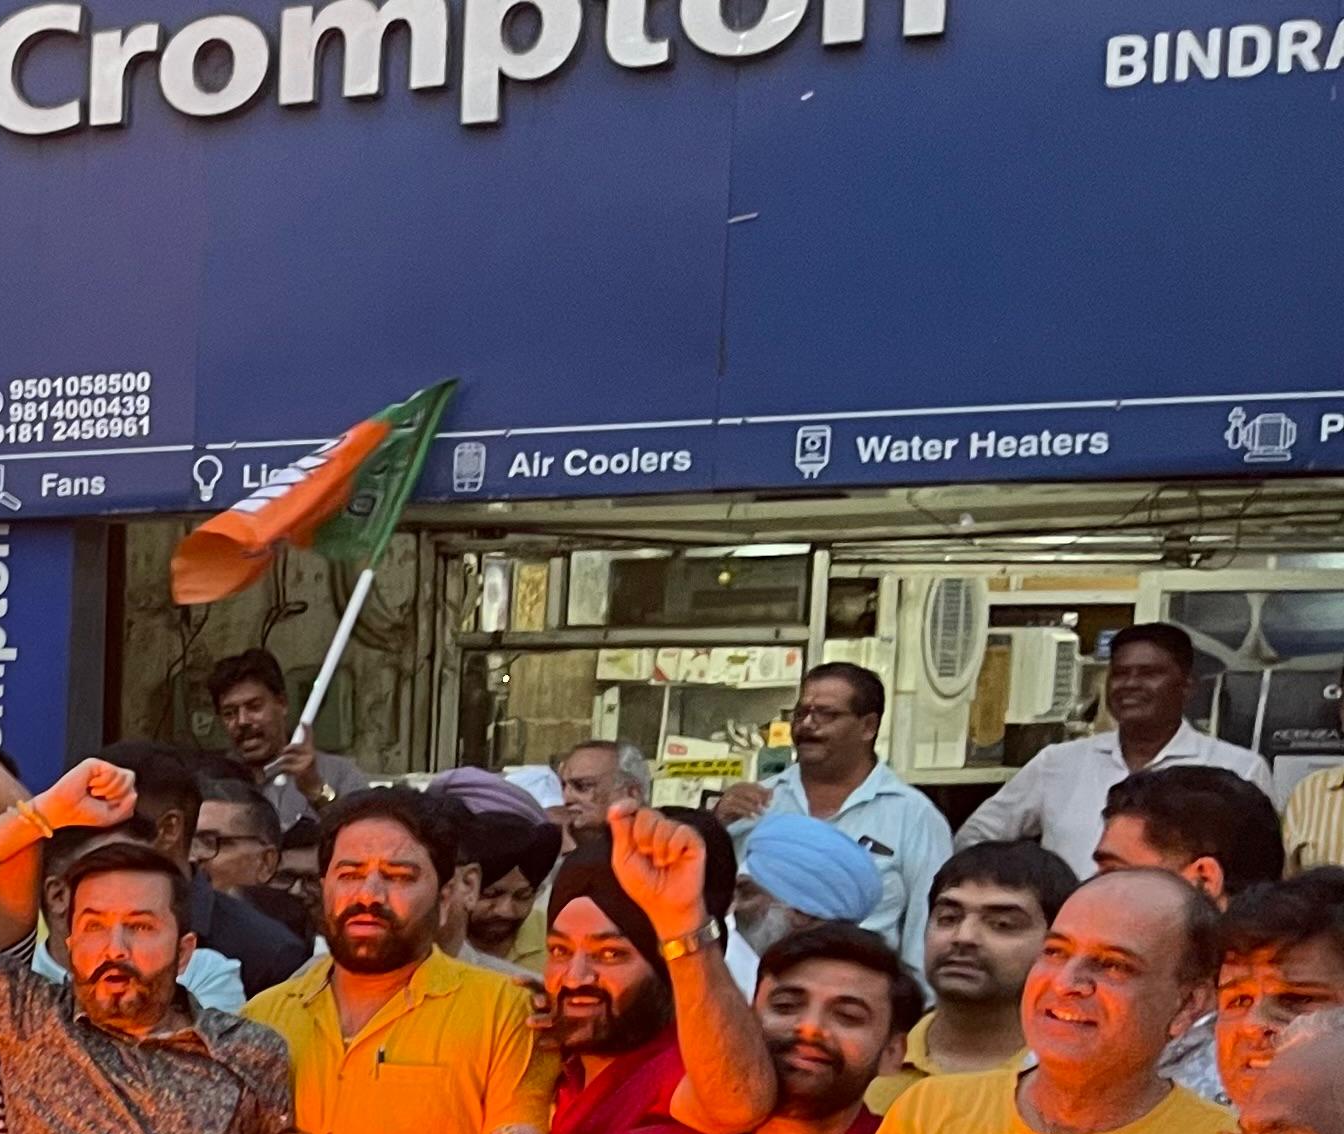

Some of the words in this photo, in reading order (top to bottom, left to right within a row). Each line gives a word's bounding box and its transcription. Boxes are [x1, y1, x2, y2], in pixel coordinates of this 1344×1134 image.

[9, 371, 151, 400] 9501058500
[9, 394, 150, 423] 9814000439
[52, 415, 150, 441] 2456961
[856, 435, 959, 464] Water
[969, 430, 1110, 460] Heaters
[508, 450, 555, 478] Air
[564, 446, 692, 477] Coolers
[41, 472, 106, 497] Fans
